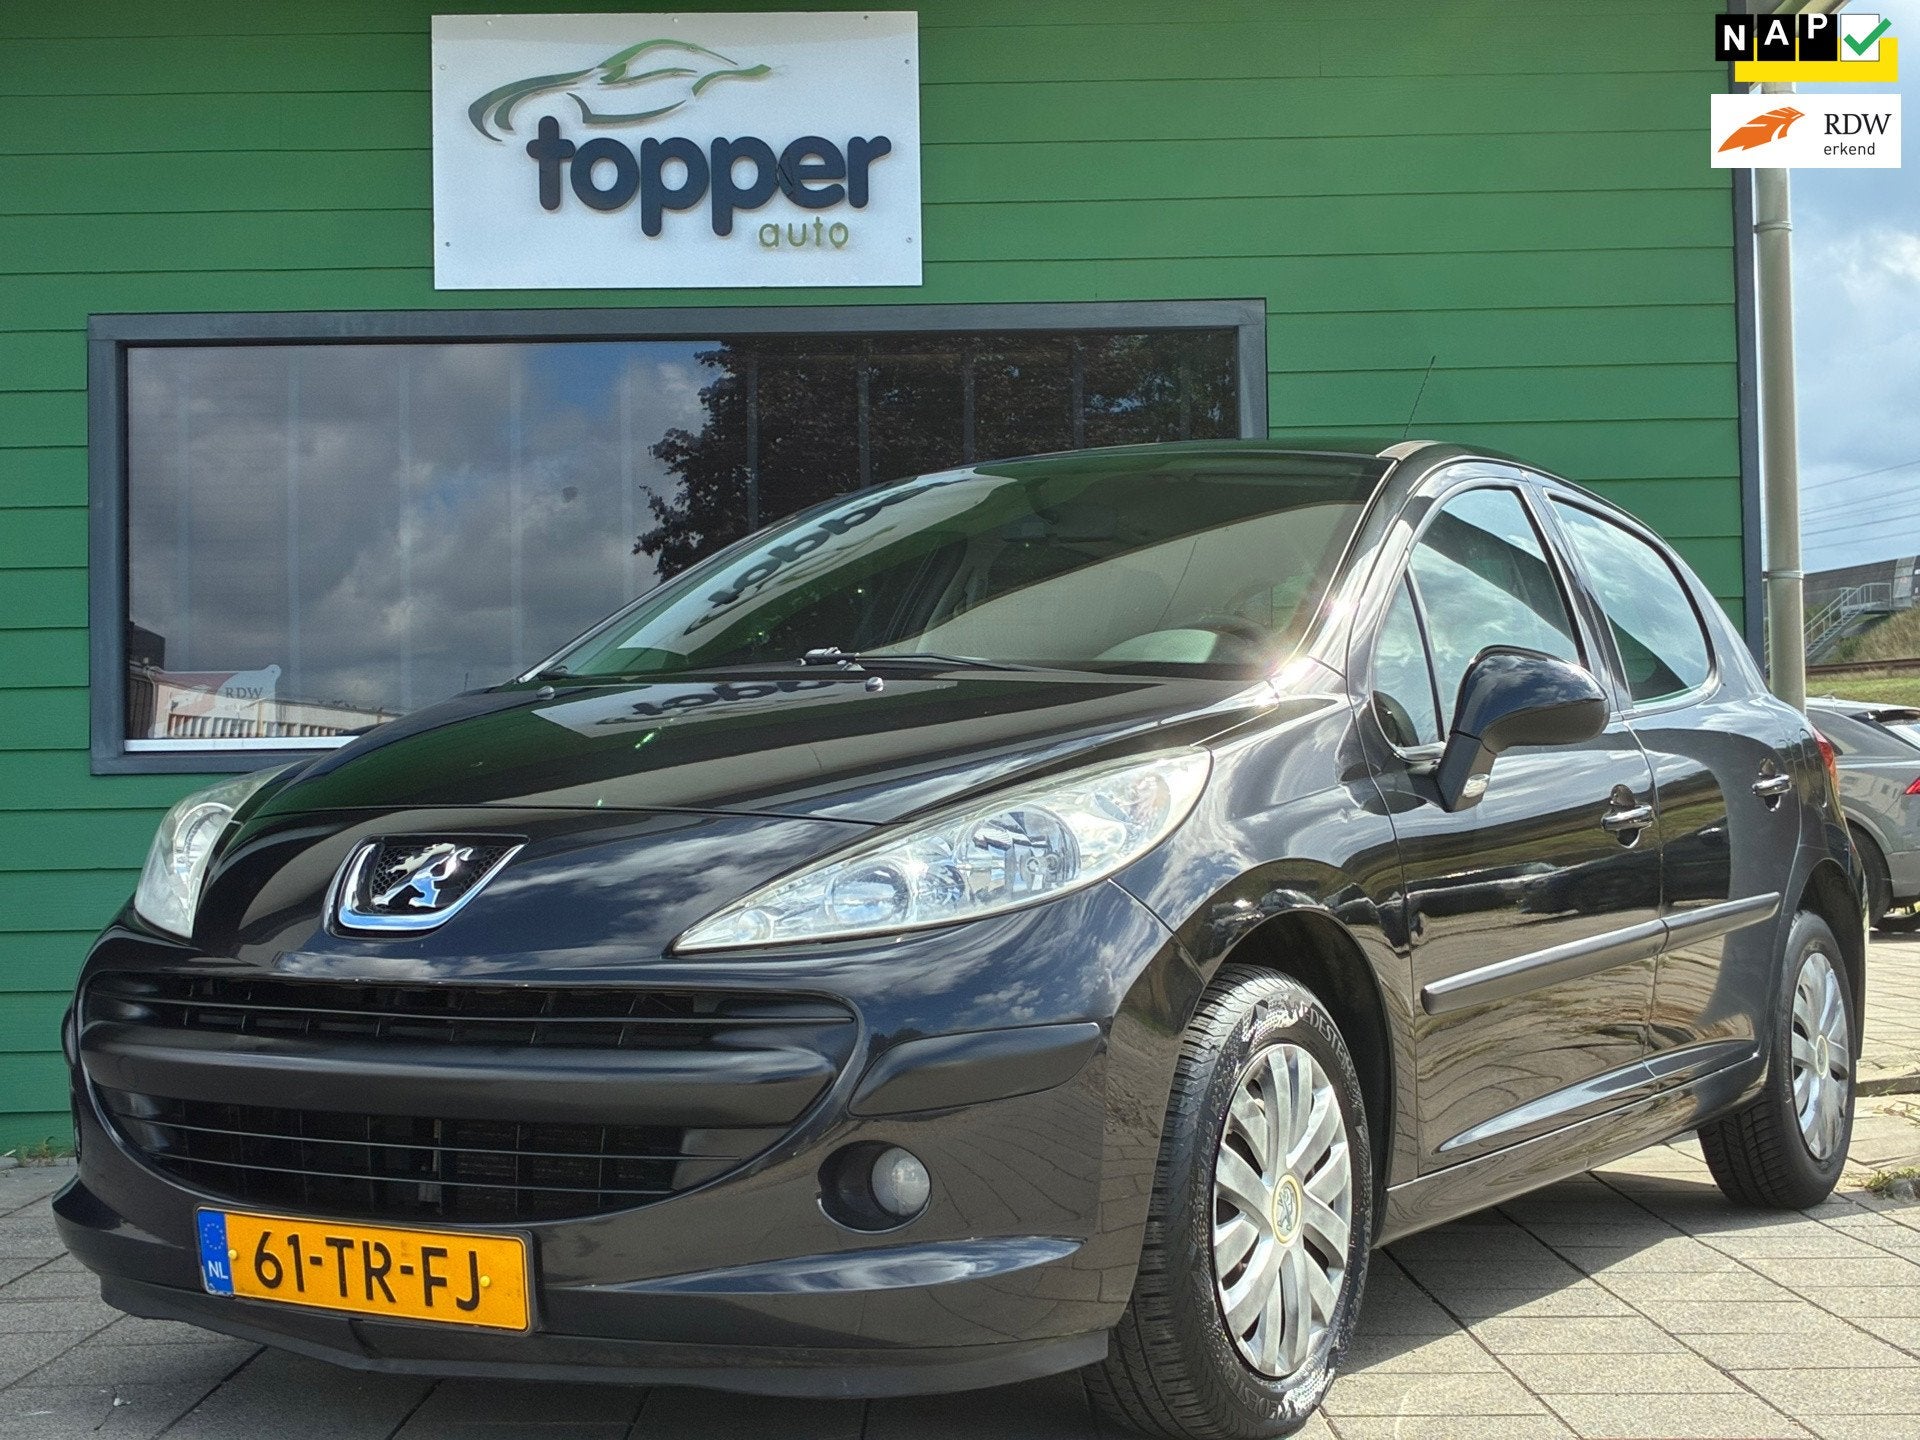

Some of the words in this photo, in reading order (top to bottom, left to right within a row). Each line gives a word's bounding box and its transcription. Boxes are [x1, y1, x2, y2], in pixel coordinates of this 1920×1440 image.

[526, 115, 892, 237] topper
[758, 216, 850, 248] auto
[225, 686, 264, 699] RDW
[208, 1260, 229, 1280] NL
[254, 1231, 481, 1311] 61-TR-FJ
